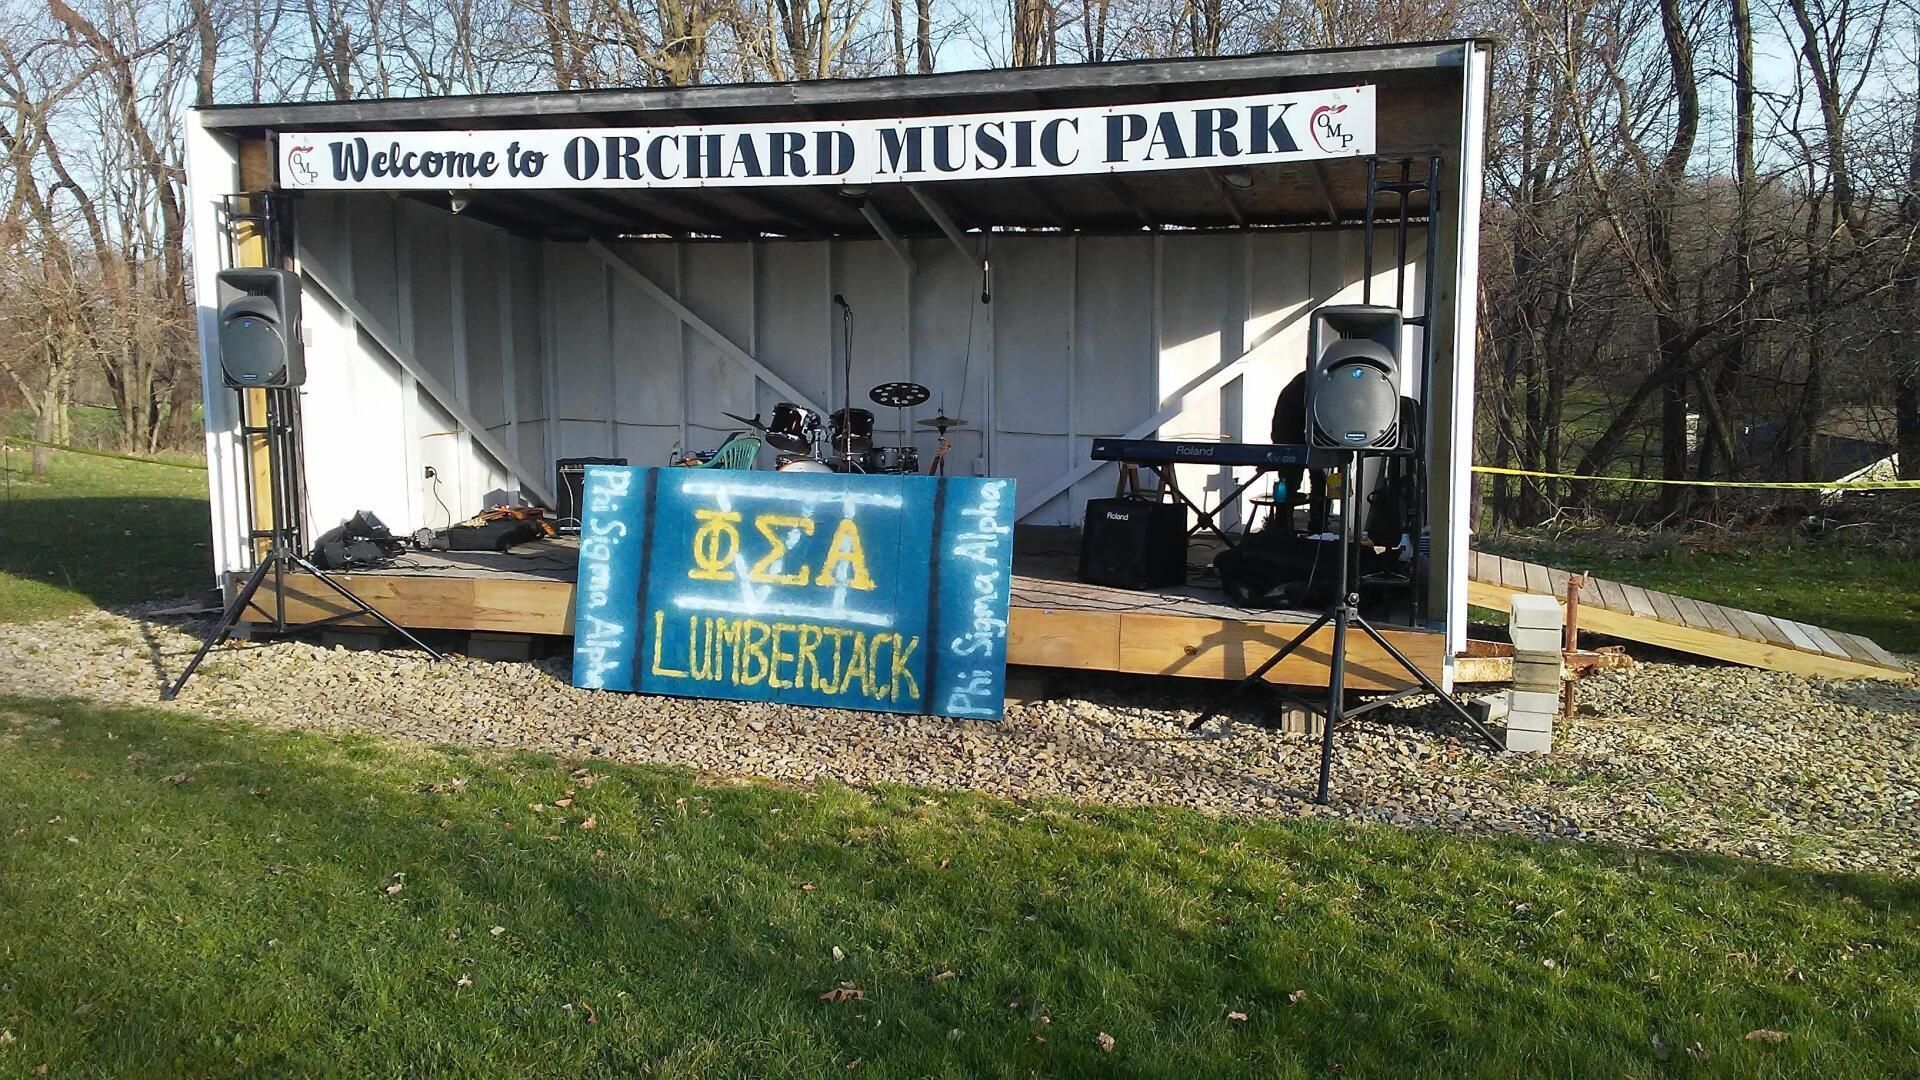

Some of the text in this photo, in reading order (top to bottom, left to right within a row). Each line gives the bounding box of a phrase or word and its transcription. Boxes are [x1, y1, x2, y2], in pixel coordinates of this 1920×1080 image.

[328, 102, 1303, 183] Welcome to ORCHARD MUSIC PARK
[1317, 113, 1354, 148] OMP
[1175, 445, 1215, 457] Roland
[589, 469, 632, 512] Phi
[1106, 511, 1129, 521] Roland
[580, 518, 628, 609] Sigma
[946, 479, 1011, 716] Phi Sigma Alpha
[651, 609, 922, 701] LUMBERJACK
